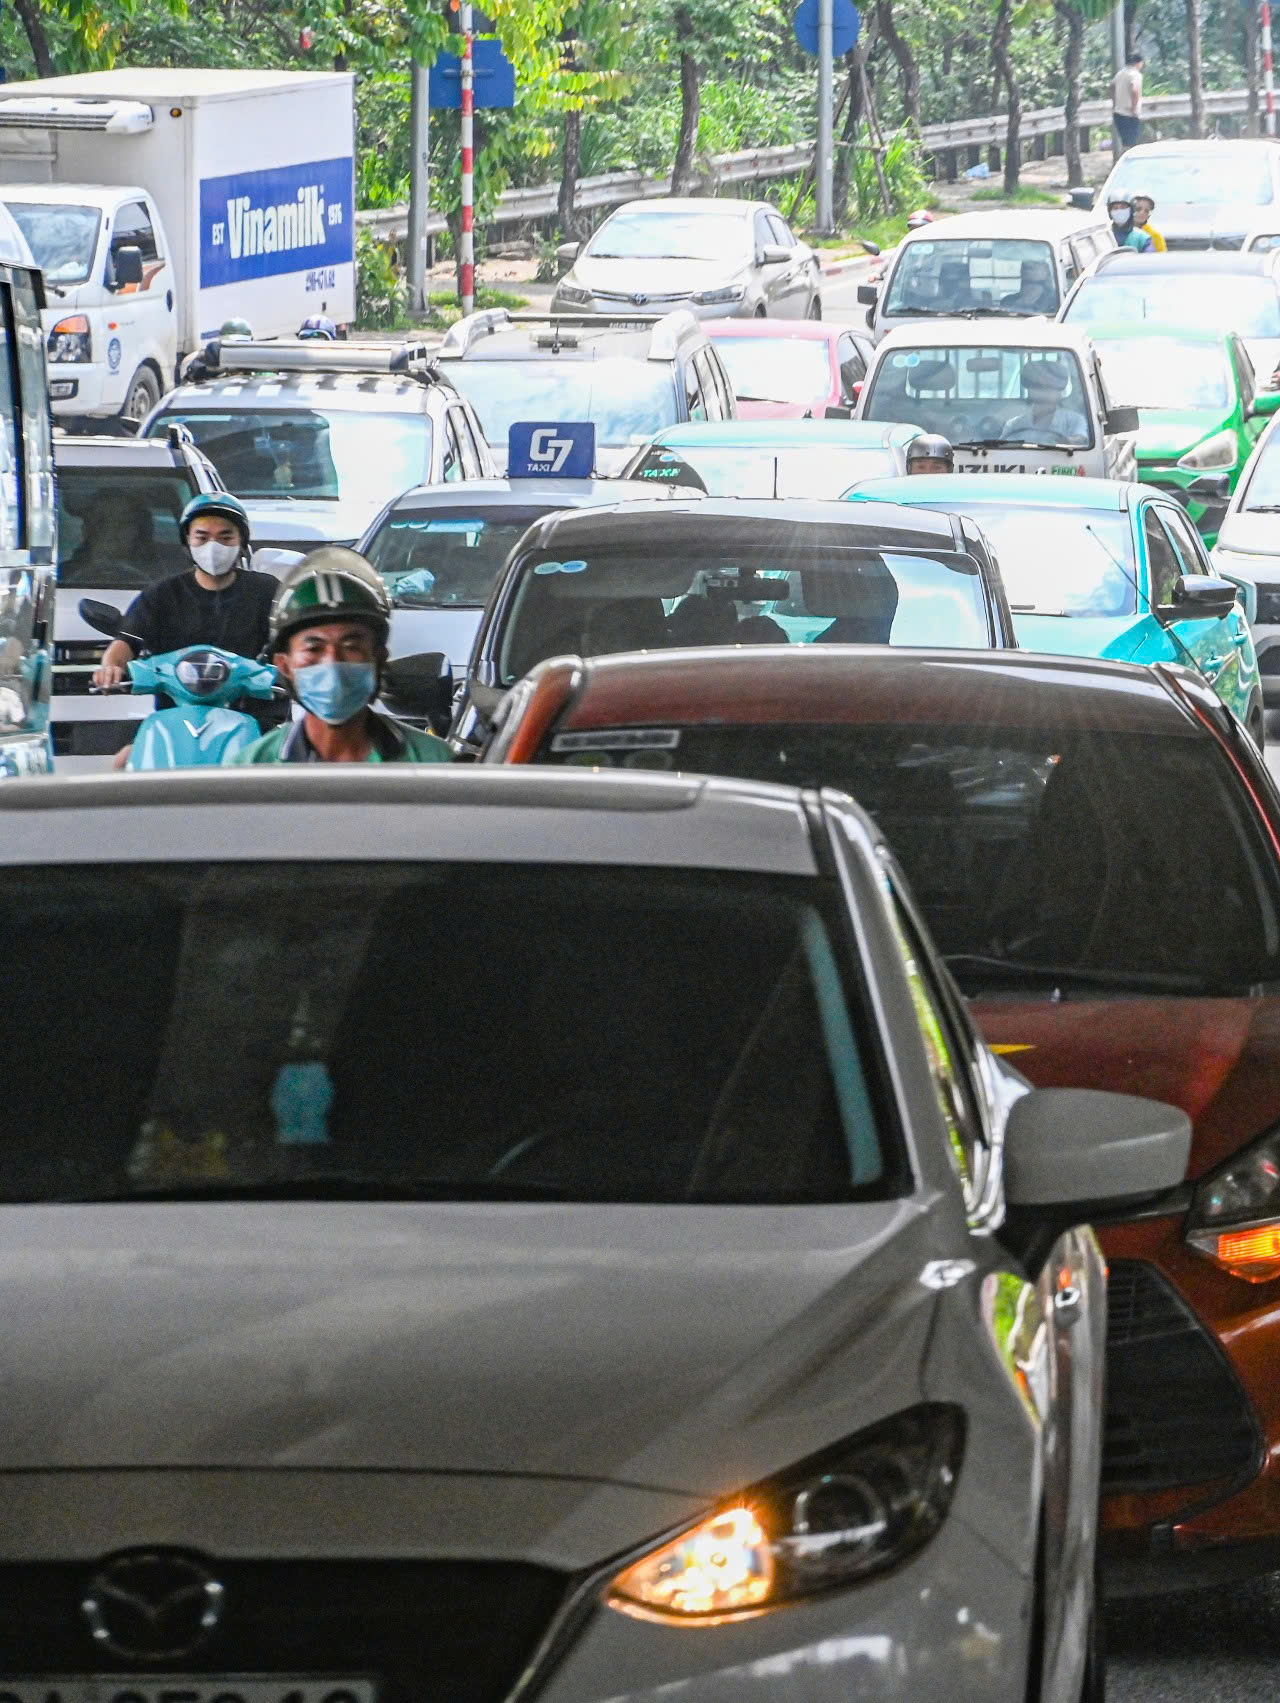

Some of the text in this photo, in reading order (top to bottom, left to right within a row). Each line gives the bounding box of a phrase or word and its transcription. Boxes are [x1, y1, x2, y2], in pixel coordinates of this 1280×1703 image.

[212, 222, 225, 246] EST
[227, 184, 326, 259] Vinamilk
[527, 463, 550, 472] TAXI
[529, 428, 574, 472] G7
